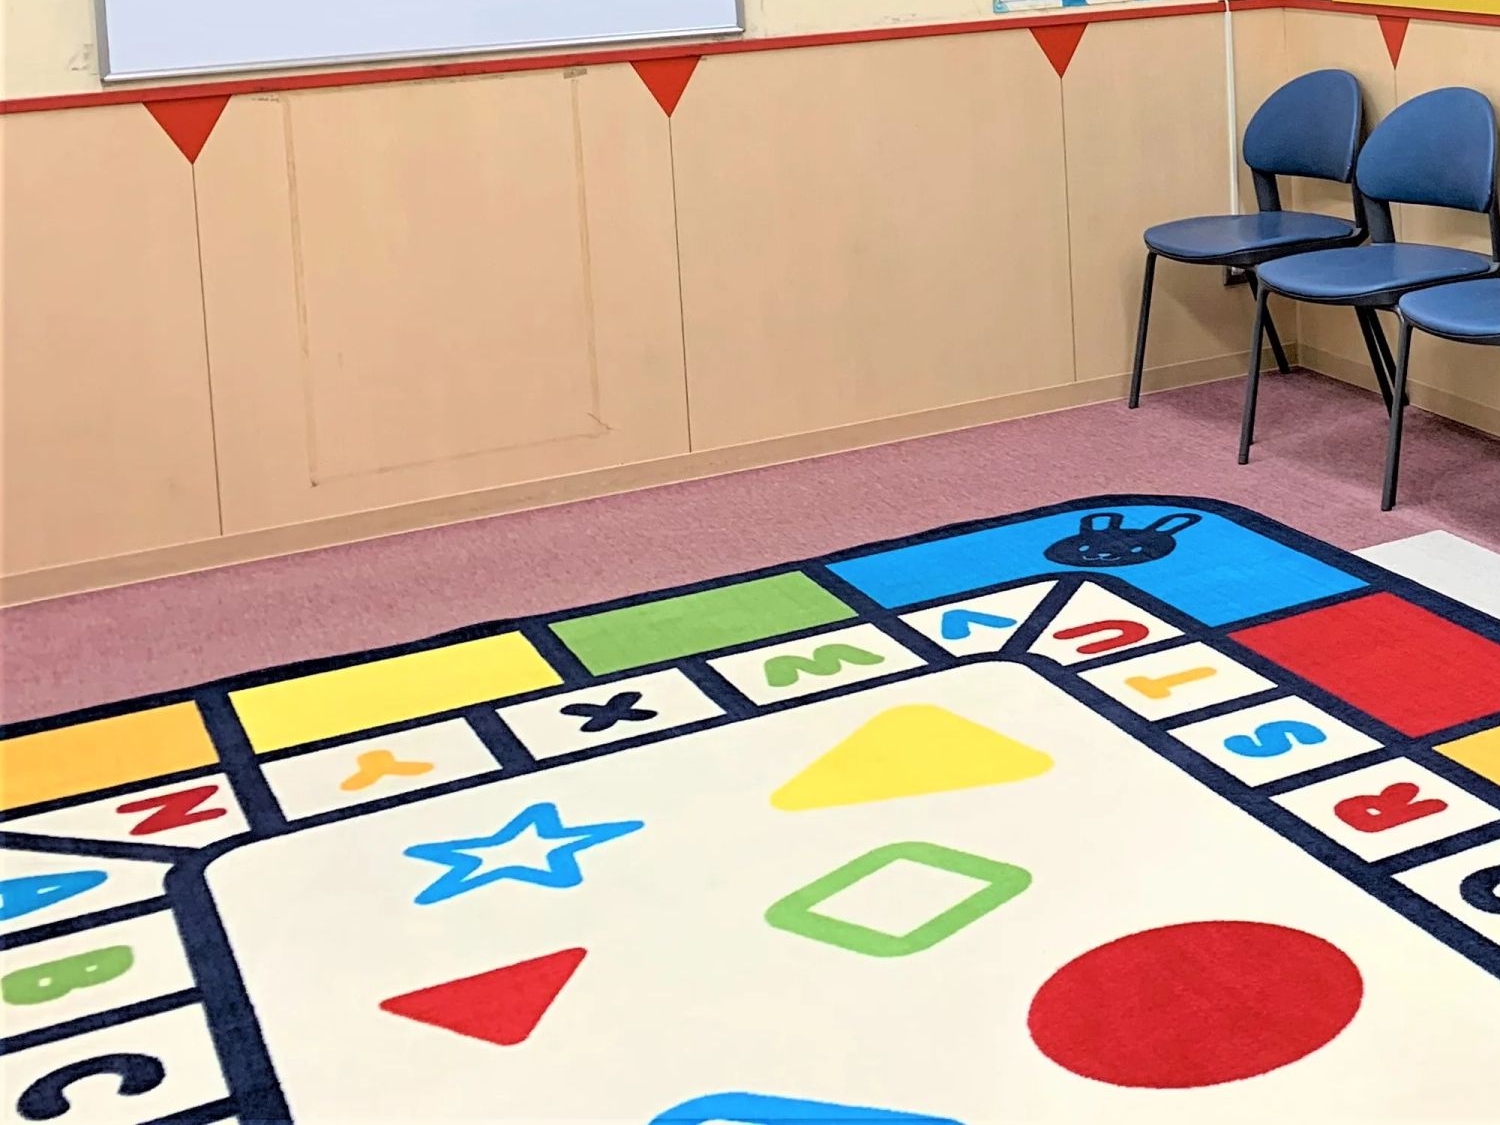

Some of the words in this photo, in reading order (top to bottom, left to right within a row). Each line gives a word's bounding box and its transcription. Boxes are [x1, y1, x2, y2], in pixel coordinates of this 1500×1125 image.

[1054, 617, 1149, 655] U
[560, 691, 658, 733] X
[1223, 719, 1327, 758] S
[1333, 781, 1448, 834] R
[1, 945, 134, 1006] B
[16, 1053, 166, 1121] C
